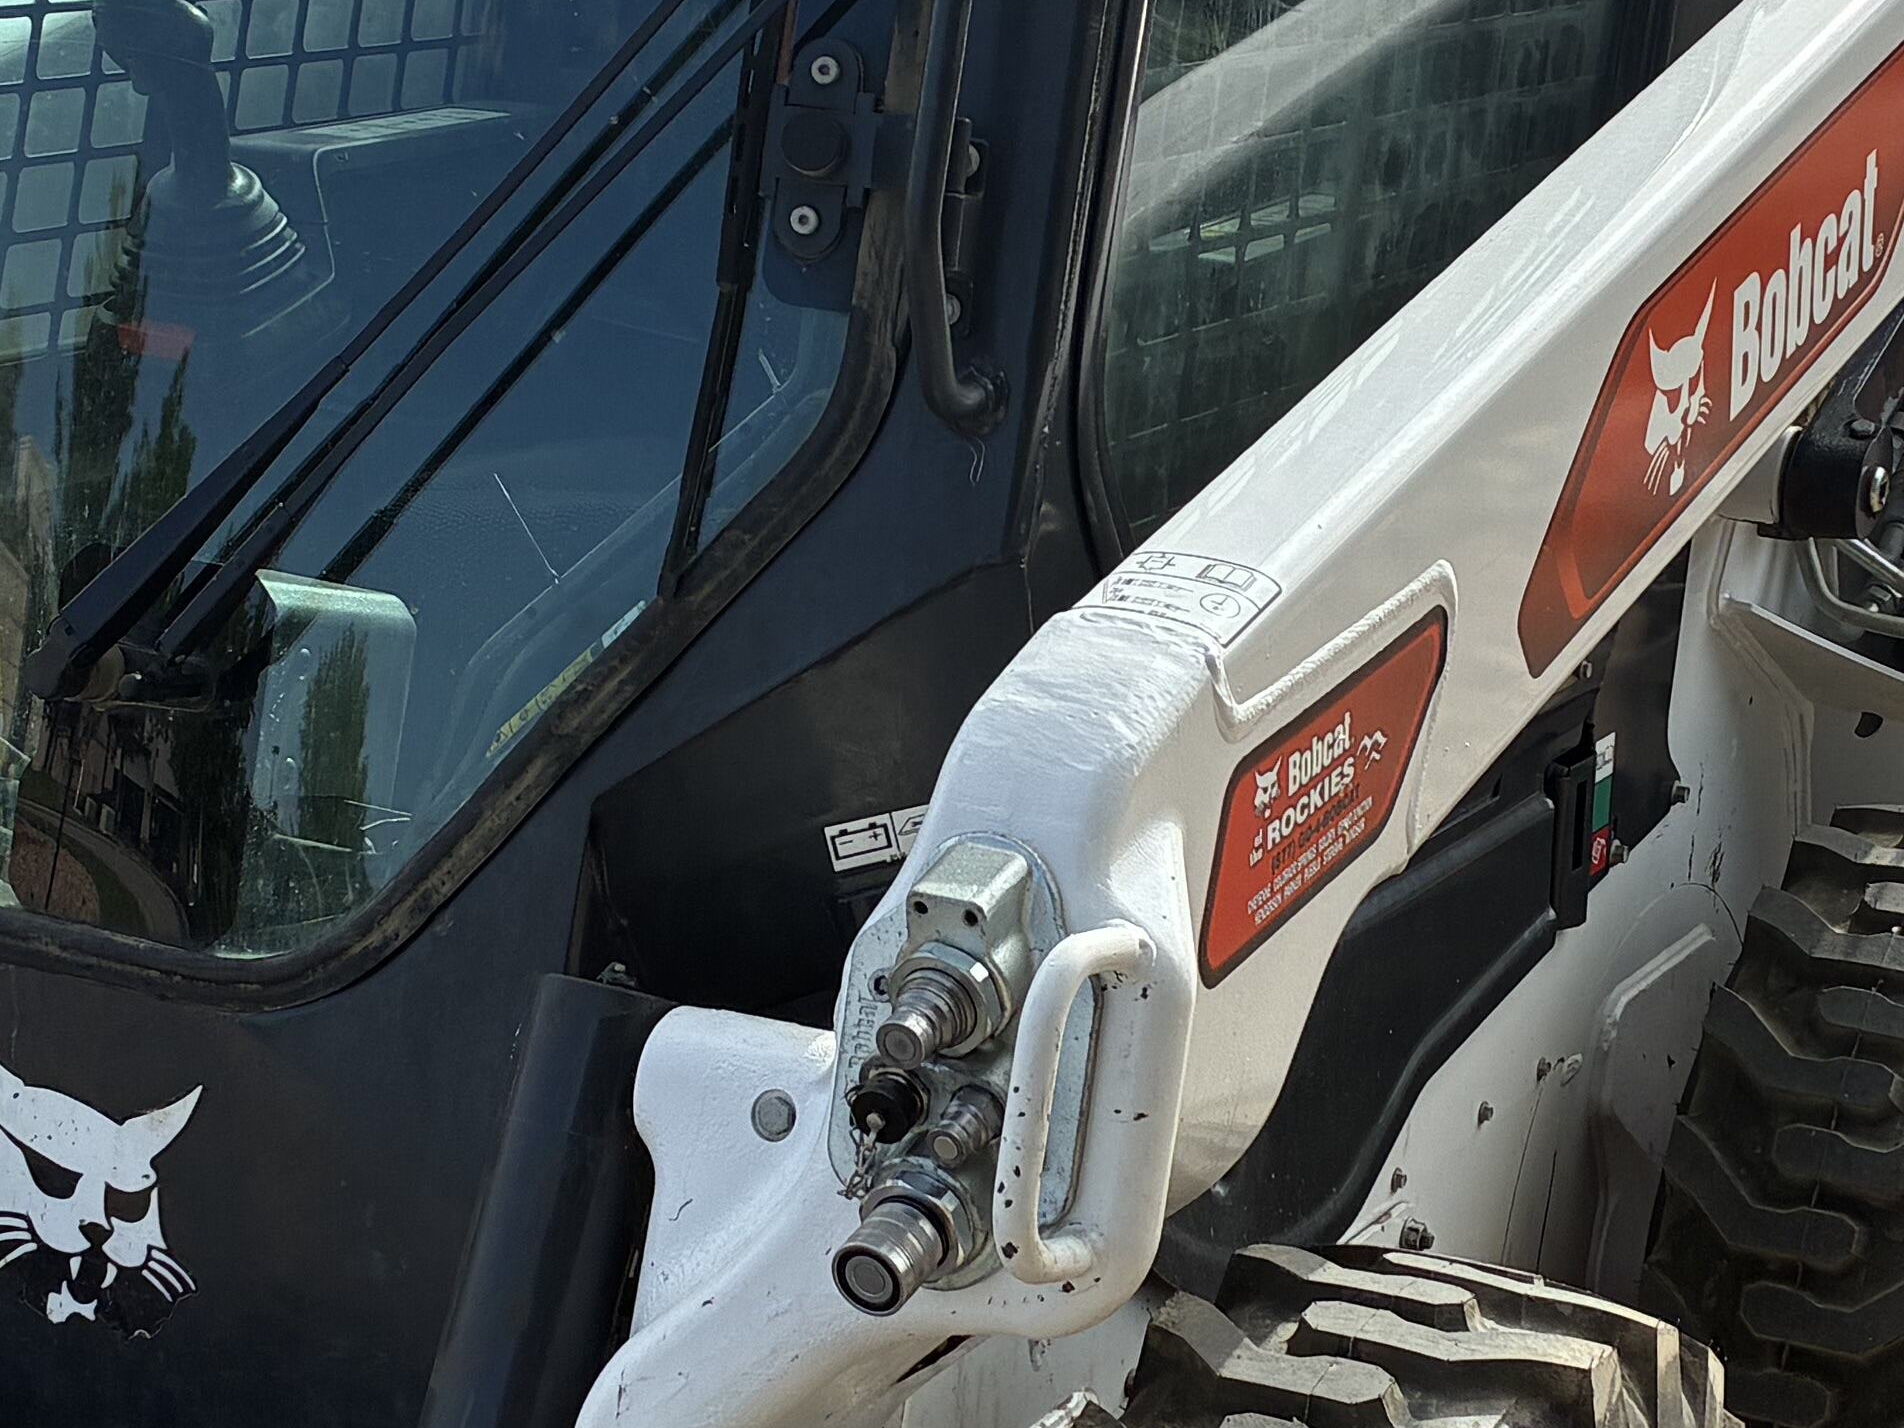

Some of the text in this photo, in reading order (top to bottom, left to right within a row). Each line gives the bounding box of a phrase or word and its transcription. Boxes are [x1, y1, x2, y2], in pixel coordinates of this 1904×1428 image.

[1730, 145, 1878, 421] Bobcat
[1287, 711, 1352, 796] Bobcat
[1267, 757, 1356, 850] ROCKIES
